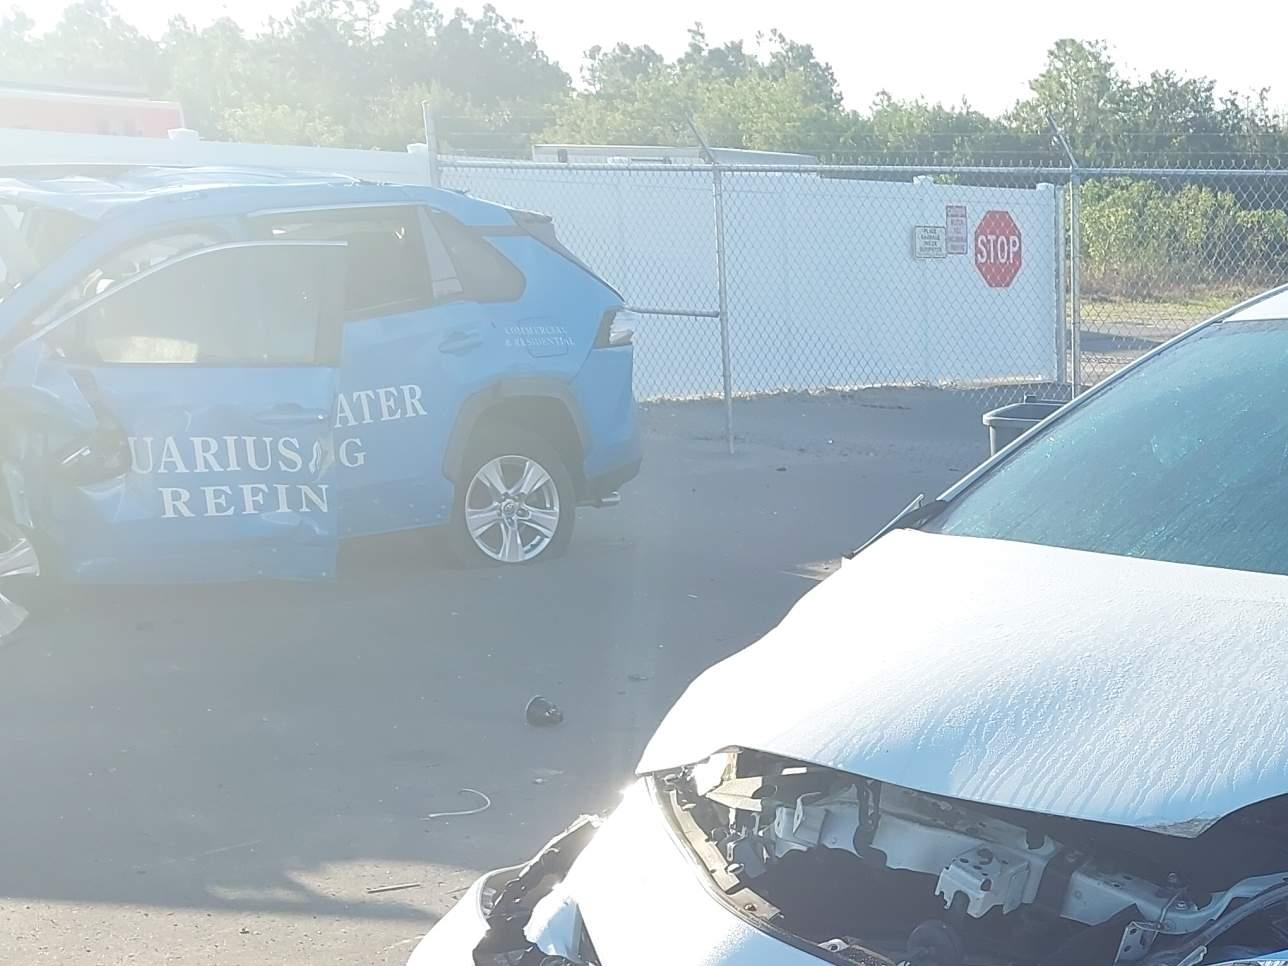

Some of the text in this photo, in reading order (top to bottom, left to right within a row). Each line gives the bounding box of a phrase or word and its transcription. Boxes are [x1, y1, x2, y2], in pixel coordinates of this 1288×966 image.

[977, 234, 1020, 264] STOP
[334, 384, 428, 428] ATER
[157, 484, 329, 518] REFIN
